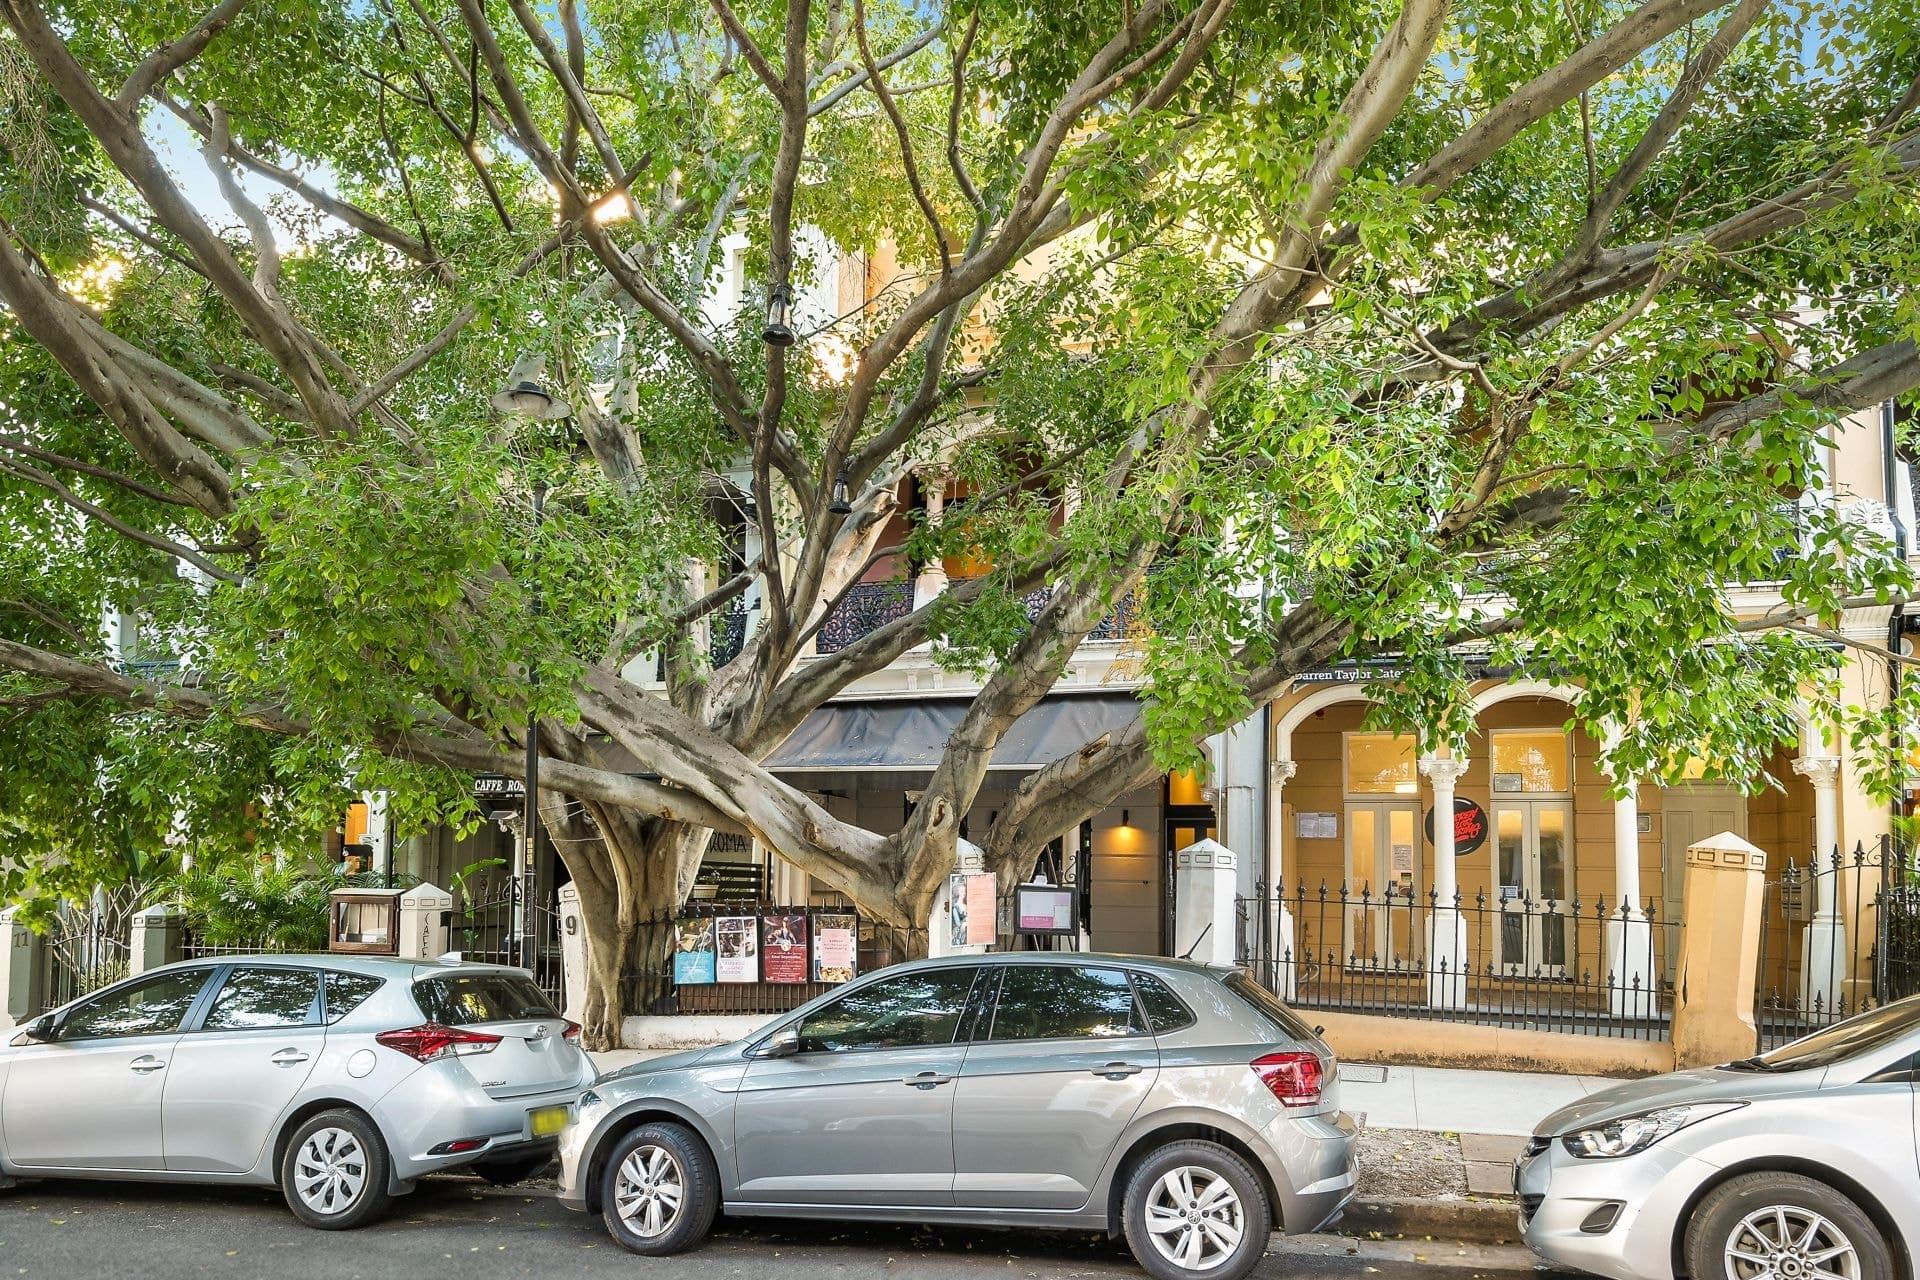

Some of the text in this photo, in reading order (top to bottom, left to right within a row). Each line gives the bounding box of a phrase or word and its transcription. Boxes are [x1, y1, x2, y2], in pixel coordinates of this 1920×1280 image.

[1335, 668, 1372, 682] Taylor
[474, 779, 503, 792] CAFFE
[710, 831, 747, 853] ROMA
[565, 914, 577, 936] 9
[14, 931, 29, 948] 11
